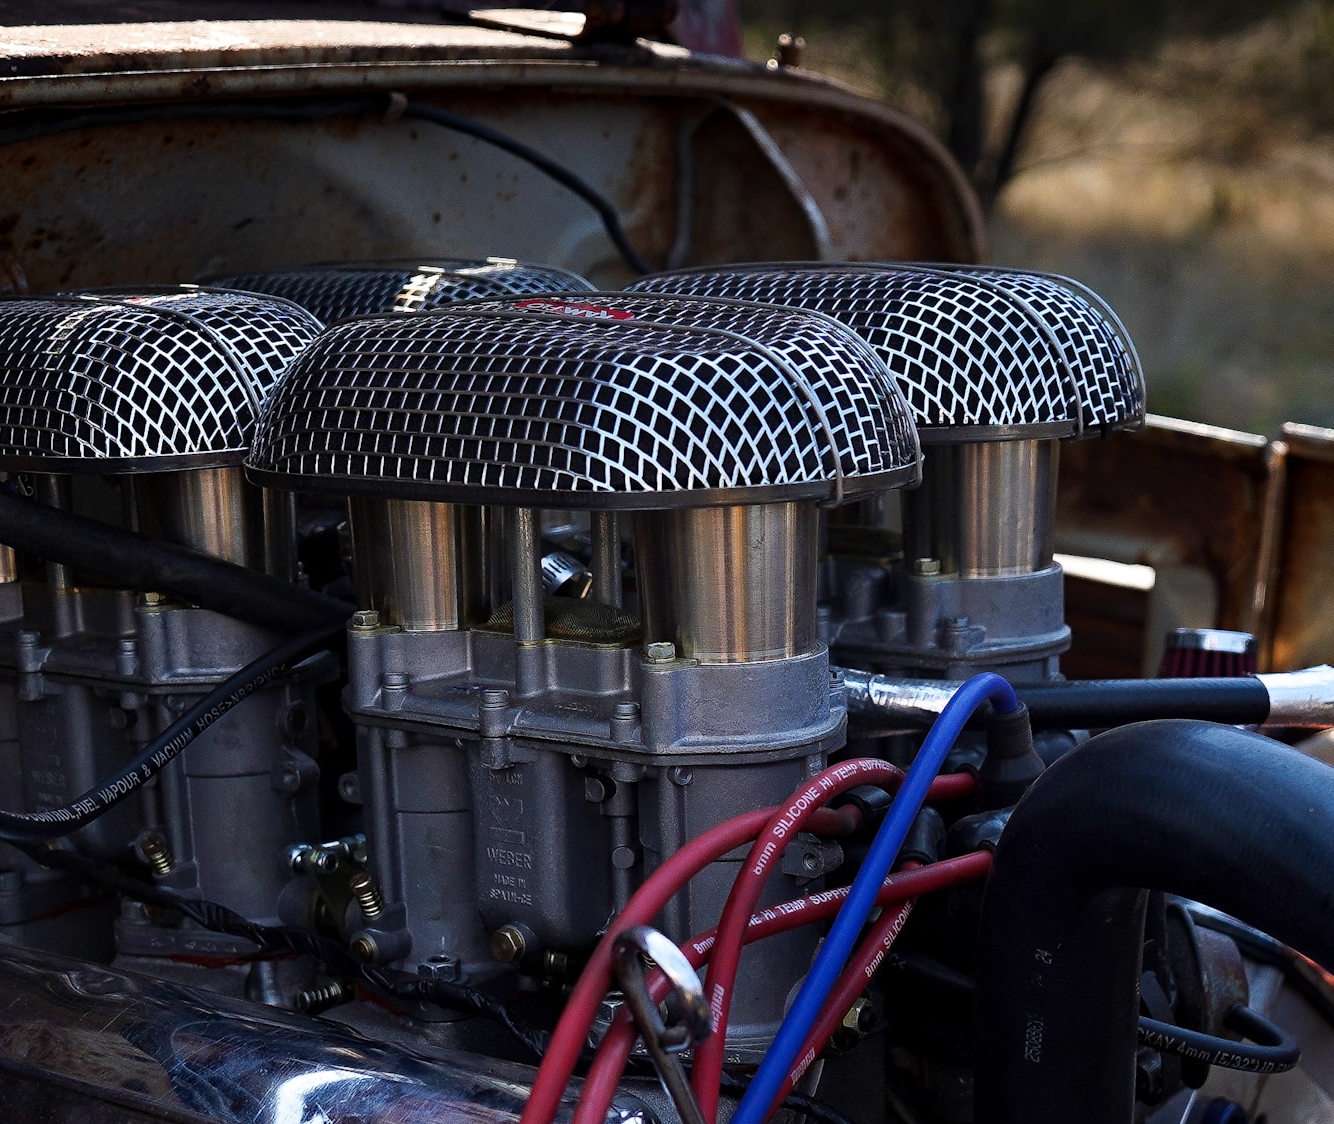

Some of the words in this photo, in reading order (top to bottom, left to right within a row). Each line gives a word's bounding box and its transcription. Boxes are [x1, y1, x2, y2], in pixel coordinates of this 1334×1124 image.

[97, 771, 140, 805] VAPOUR
[141, 761, 152, 777] &
[150, 728, 194, 769] VACUUM
[772, 786, 821, 839] SILICONE
[818, 775, 835, 792] HI
[832, 763, 858, 782] TEMP
[486, 846, 533, 871] WEBER
[777, 898, 806, 917] TEMP
[864, 950, 885, 978] 8mm
[883, 899, 913, 950] SILICONE
[1175, 1040, 1211, 1062] 4mm
